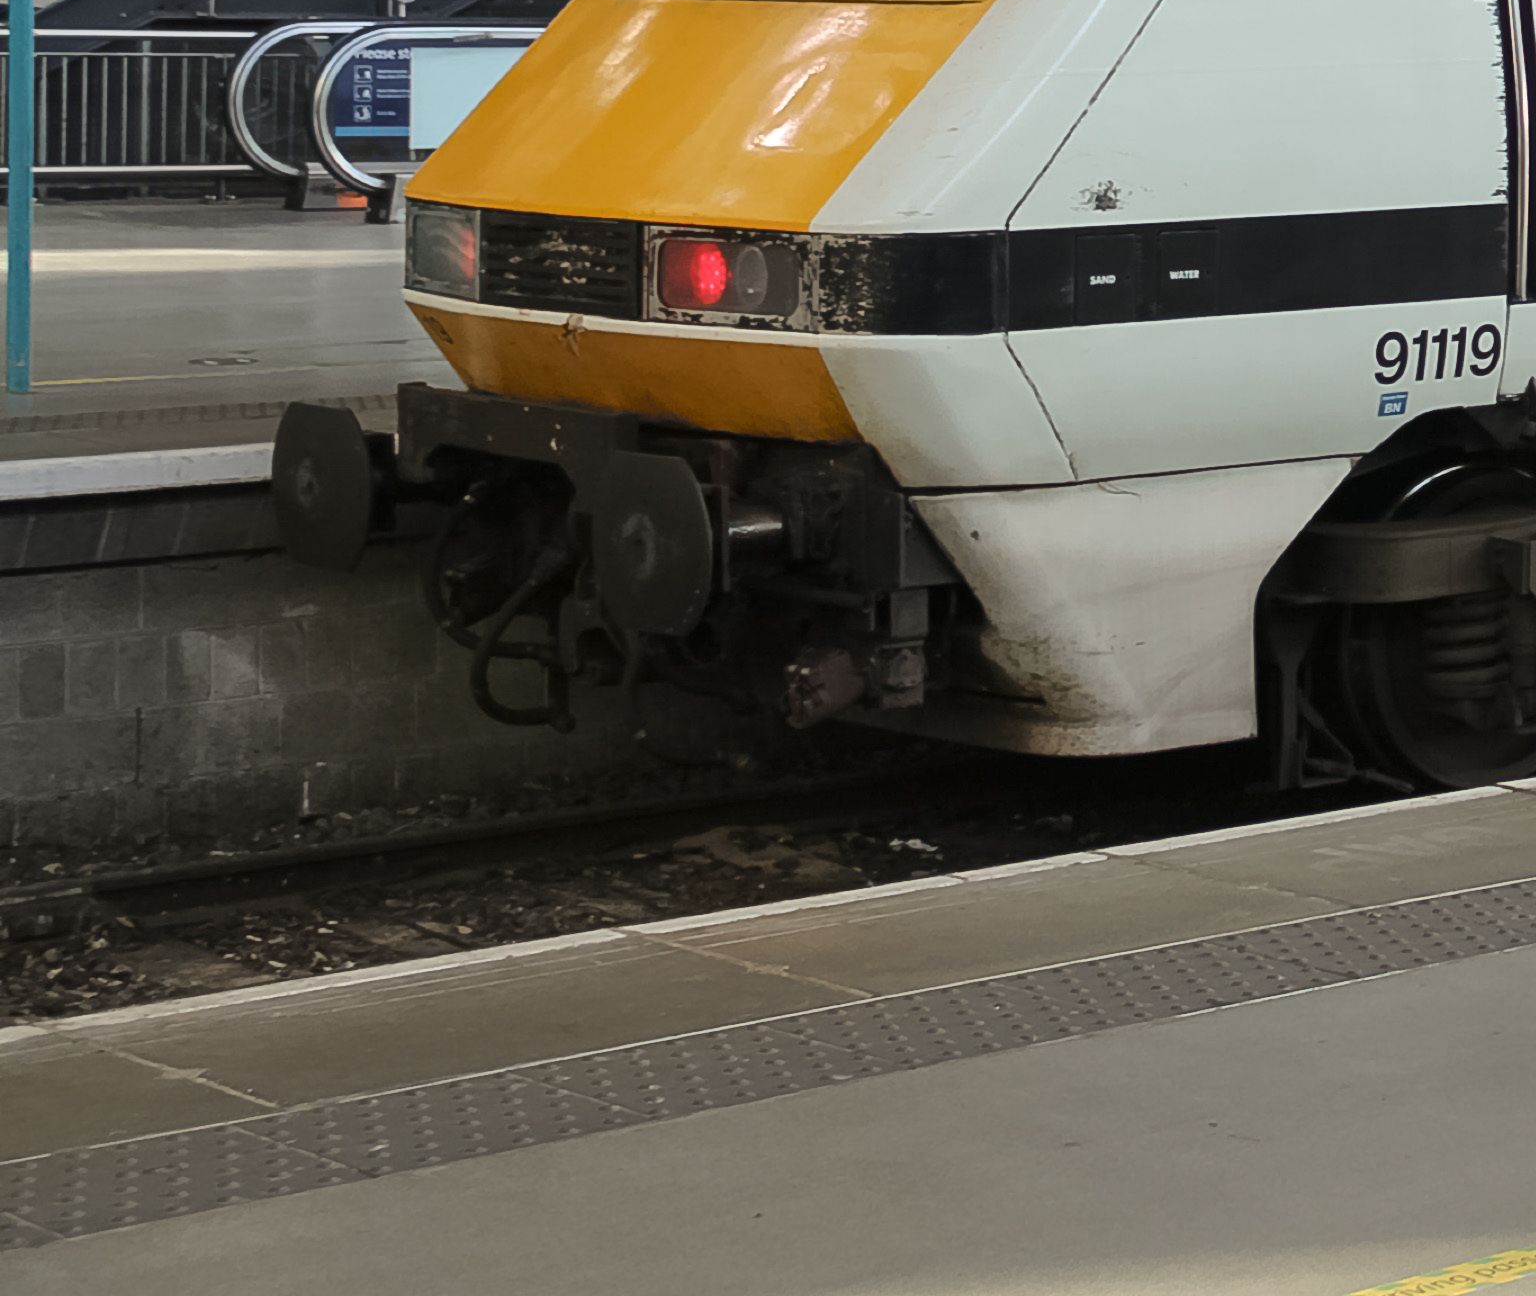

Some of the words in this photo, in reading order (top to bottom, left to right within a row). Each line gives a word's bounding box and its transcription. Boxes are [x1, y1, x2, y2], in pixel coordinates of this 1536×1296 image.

[1089, 274, 1116, 285] SAND
[1169, 270, 1200, 280] WATER
[1374, 323, 1501, 385] 91119
[1383, 402, 1402, 414] BN
